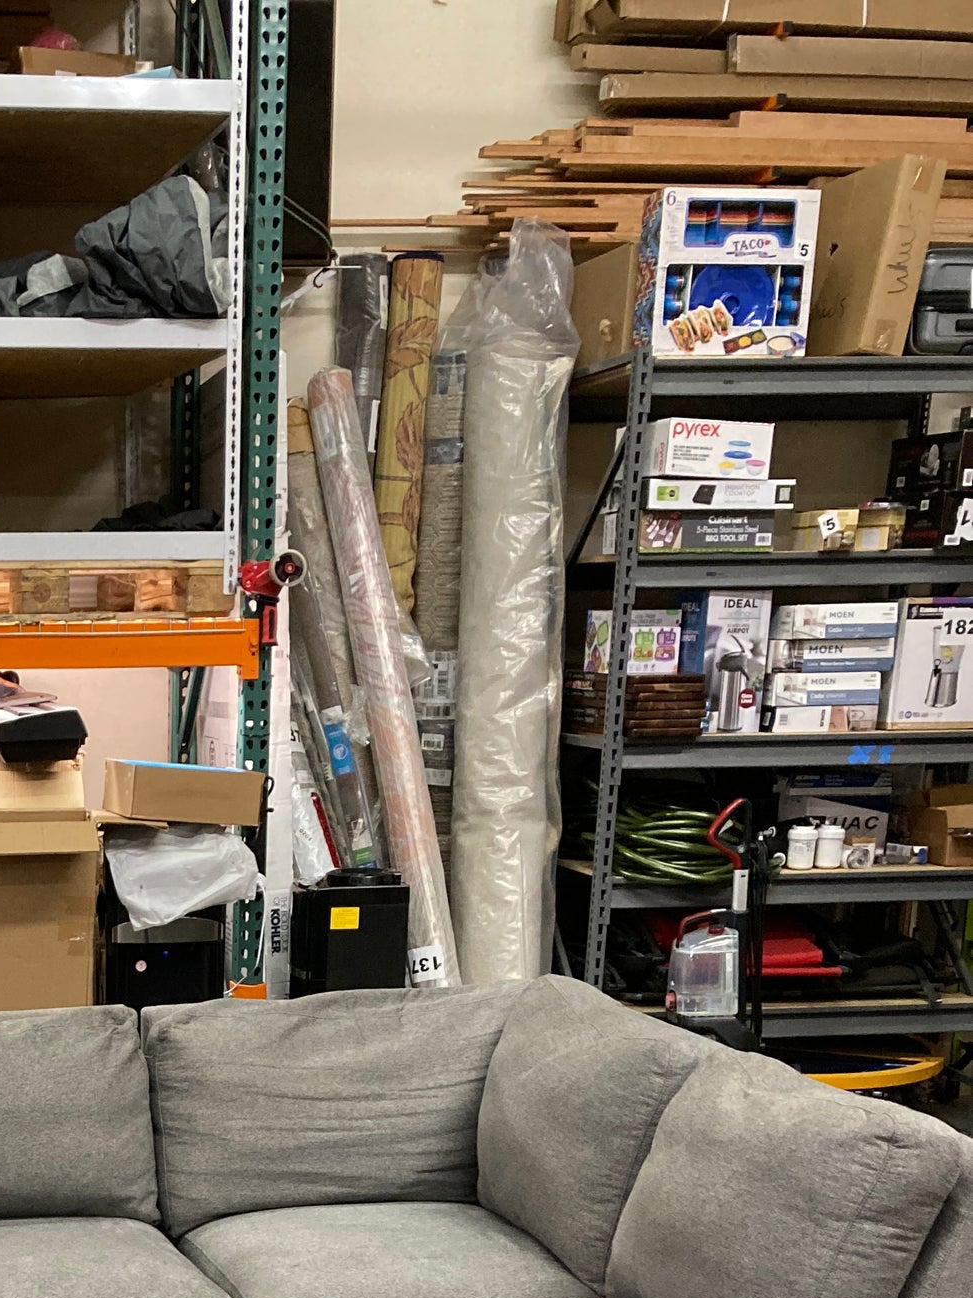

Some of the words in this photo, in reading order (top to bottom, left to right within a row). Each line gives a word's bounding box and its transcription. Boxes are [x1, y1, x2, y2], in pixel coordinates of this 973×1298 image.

[666, 191, 677, 206] 6
[732, 238, 765, 251] TACO
[672, 421, 721, 439] pyrex
[708, 515, 748, 524] Cuisinart
[719, 525, 744, 533] Stainless
[744, 524, 759, 533] Steel
[705, 534, 719, 542] BBQ
[720, 534, 737, 542] TOOL
[737, 533, 749, 542] SET
[723, 598, 759, 609] IDEAL
[808, 645, 844, 654] MOEN
